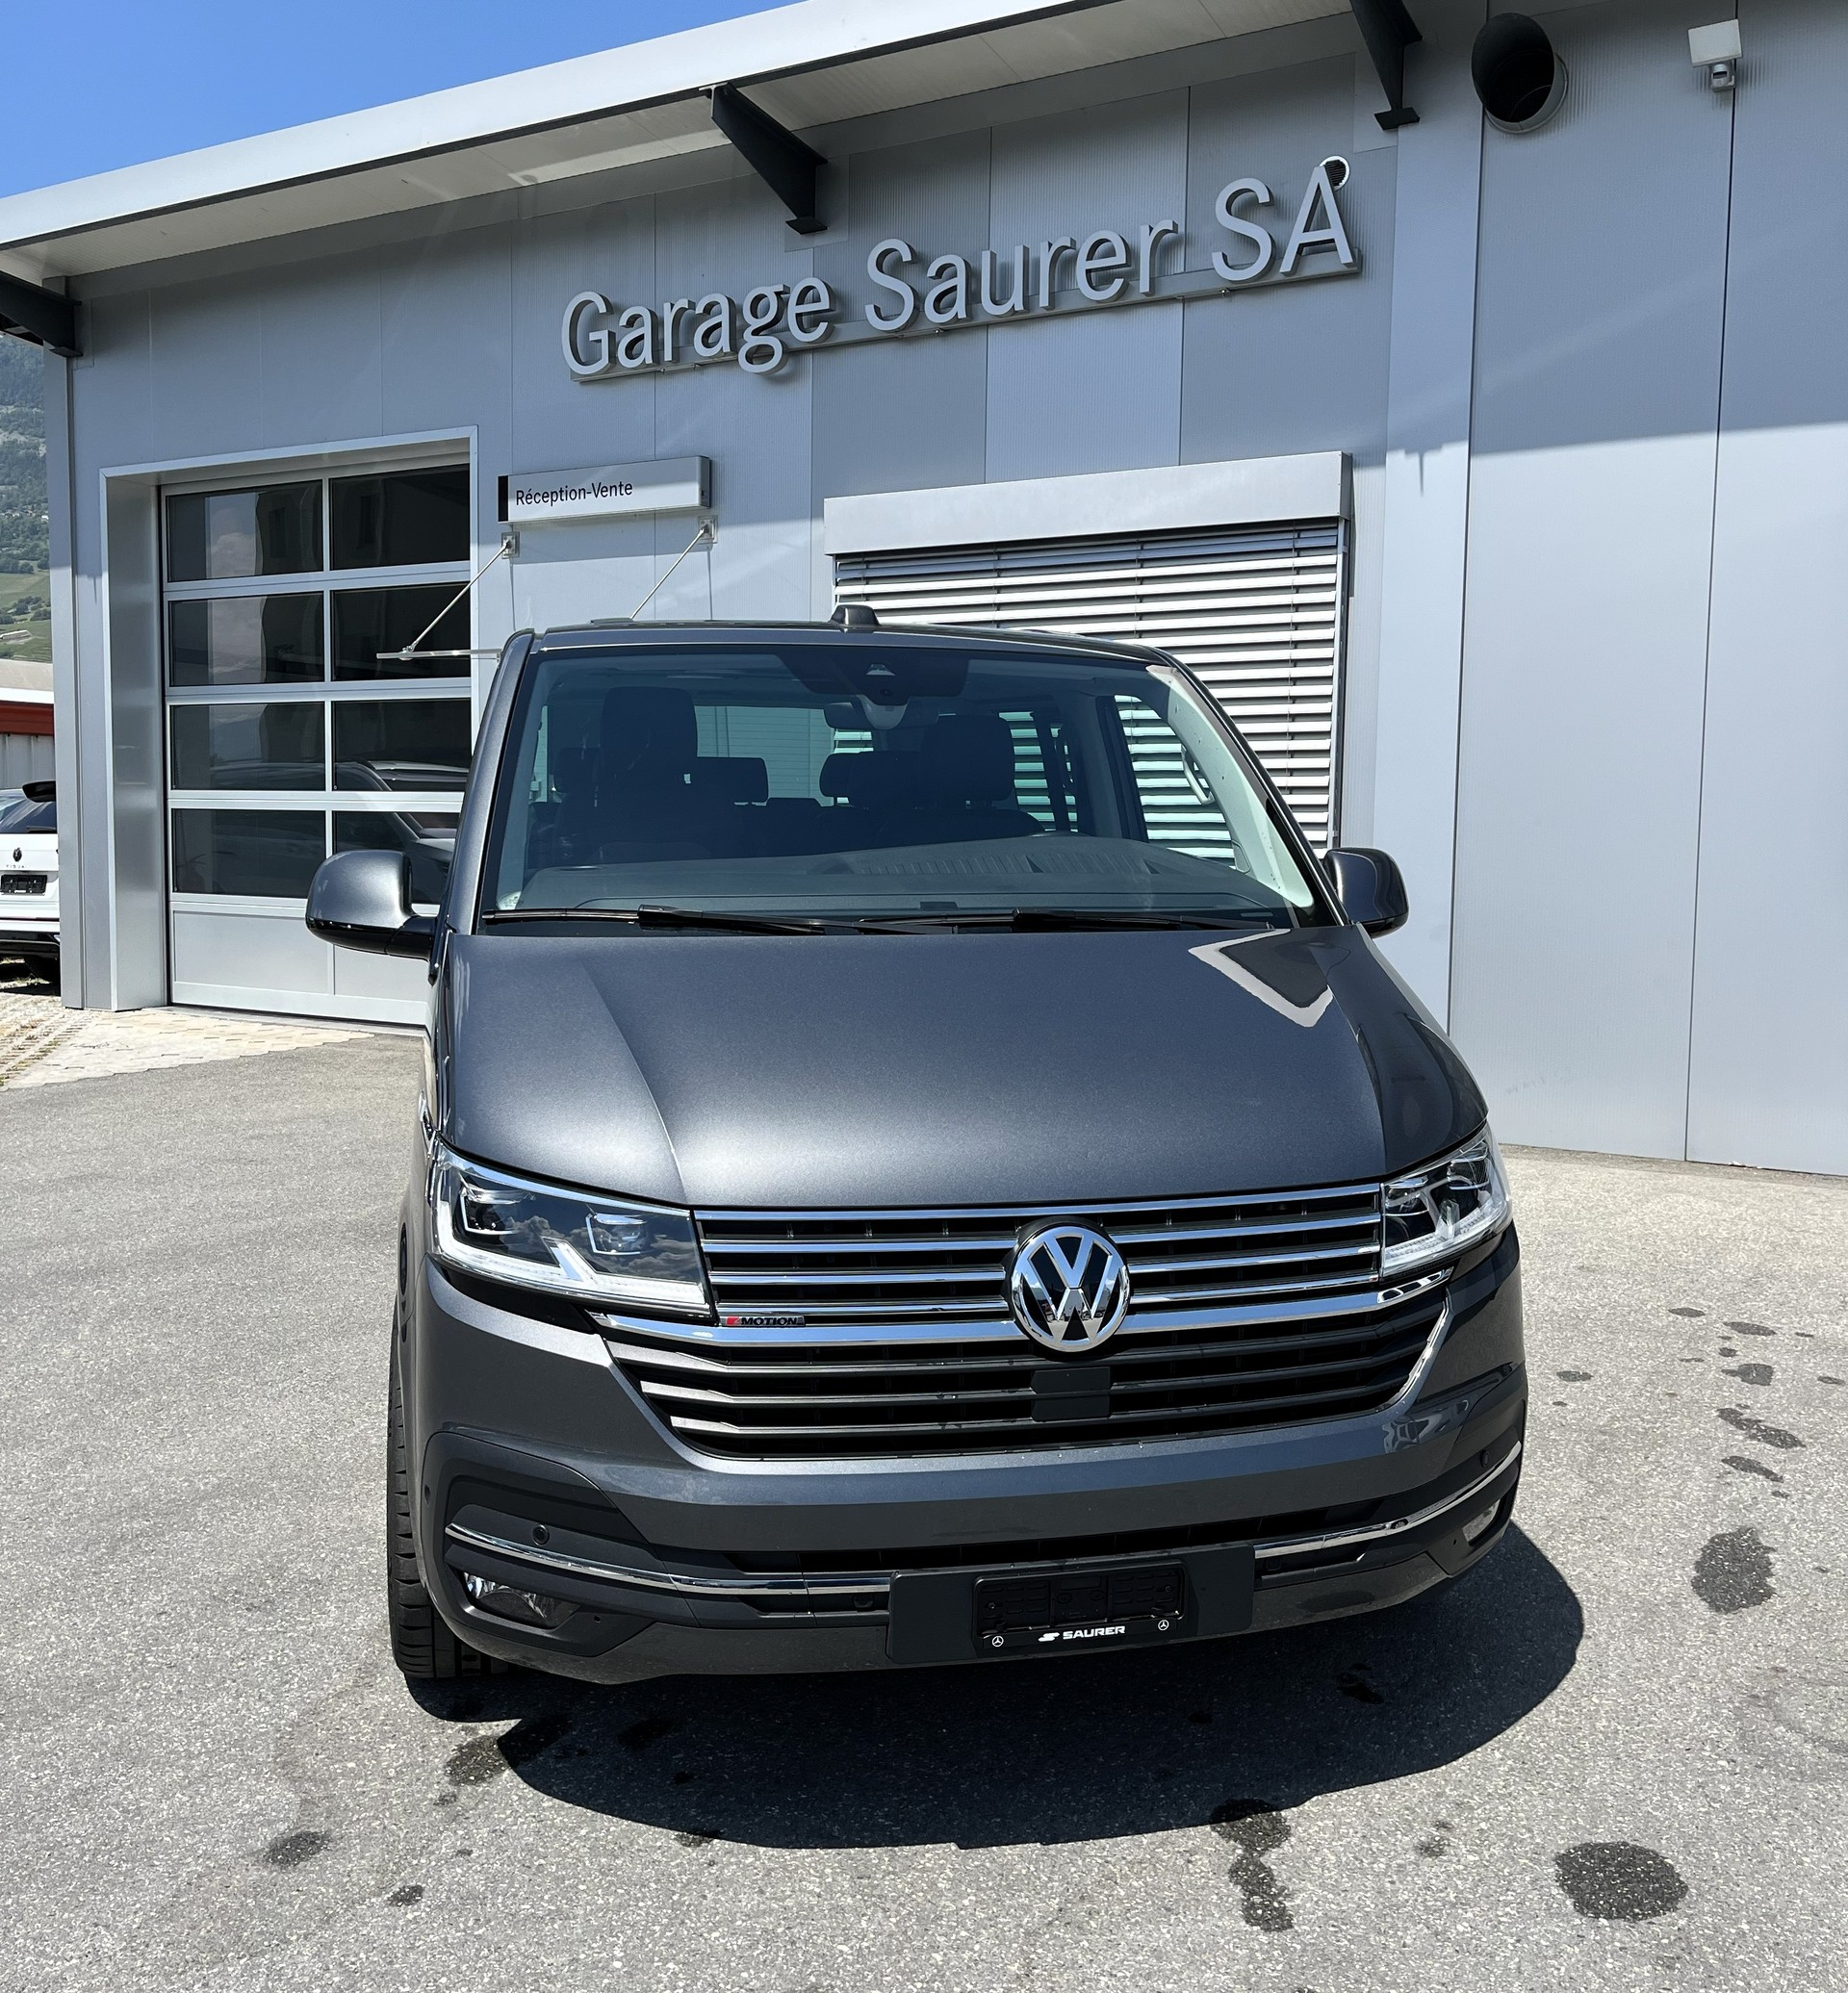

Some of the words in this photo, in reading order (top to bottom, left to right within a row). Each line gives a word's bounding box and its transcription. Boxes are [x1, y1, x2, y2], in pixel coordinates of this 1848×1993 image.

[561, 275, 833, 375] Garage
[864, 218, 1178, 332] Saurer
[1211, 165, 1354, 282] SA
[515, 481, 633, 507] Réception-Vente
[1012, 1226, 1130, 1352] VW
[1063, 1625, 1125, 1640] SAURER
